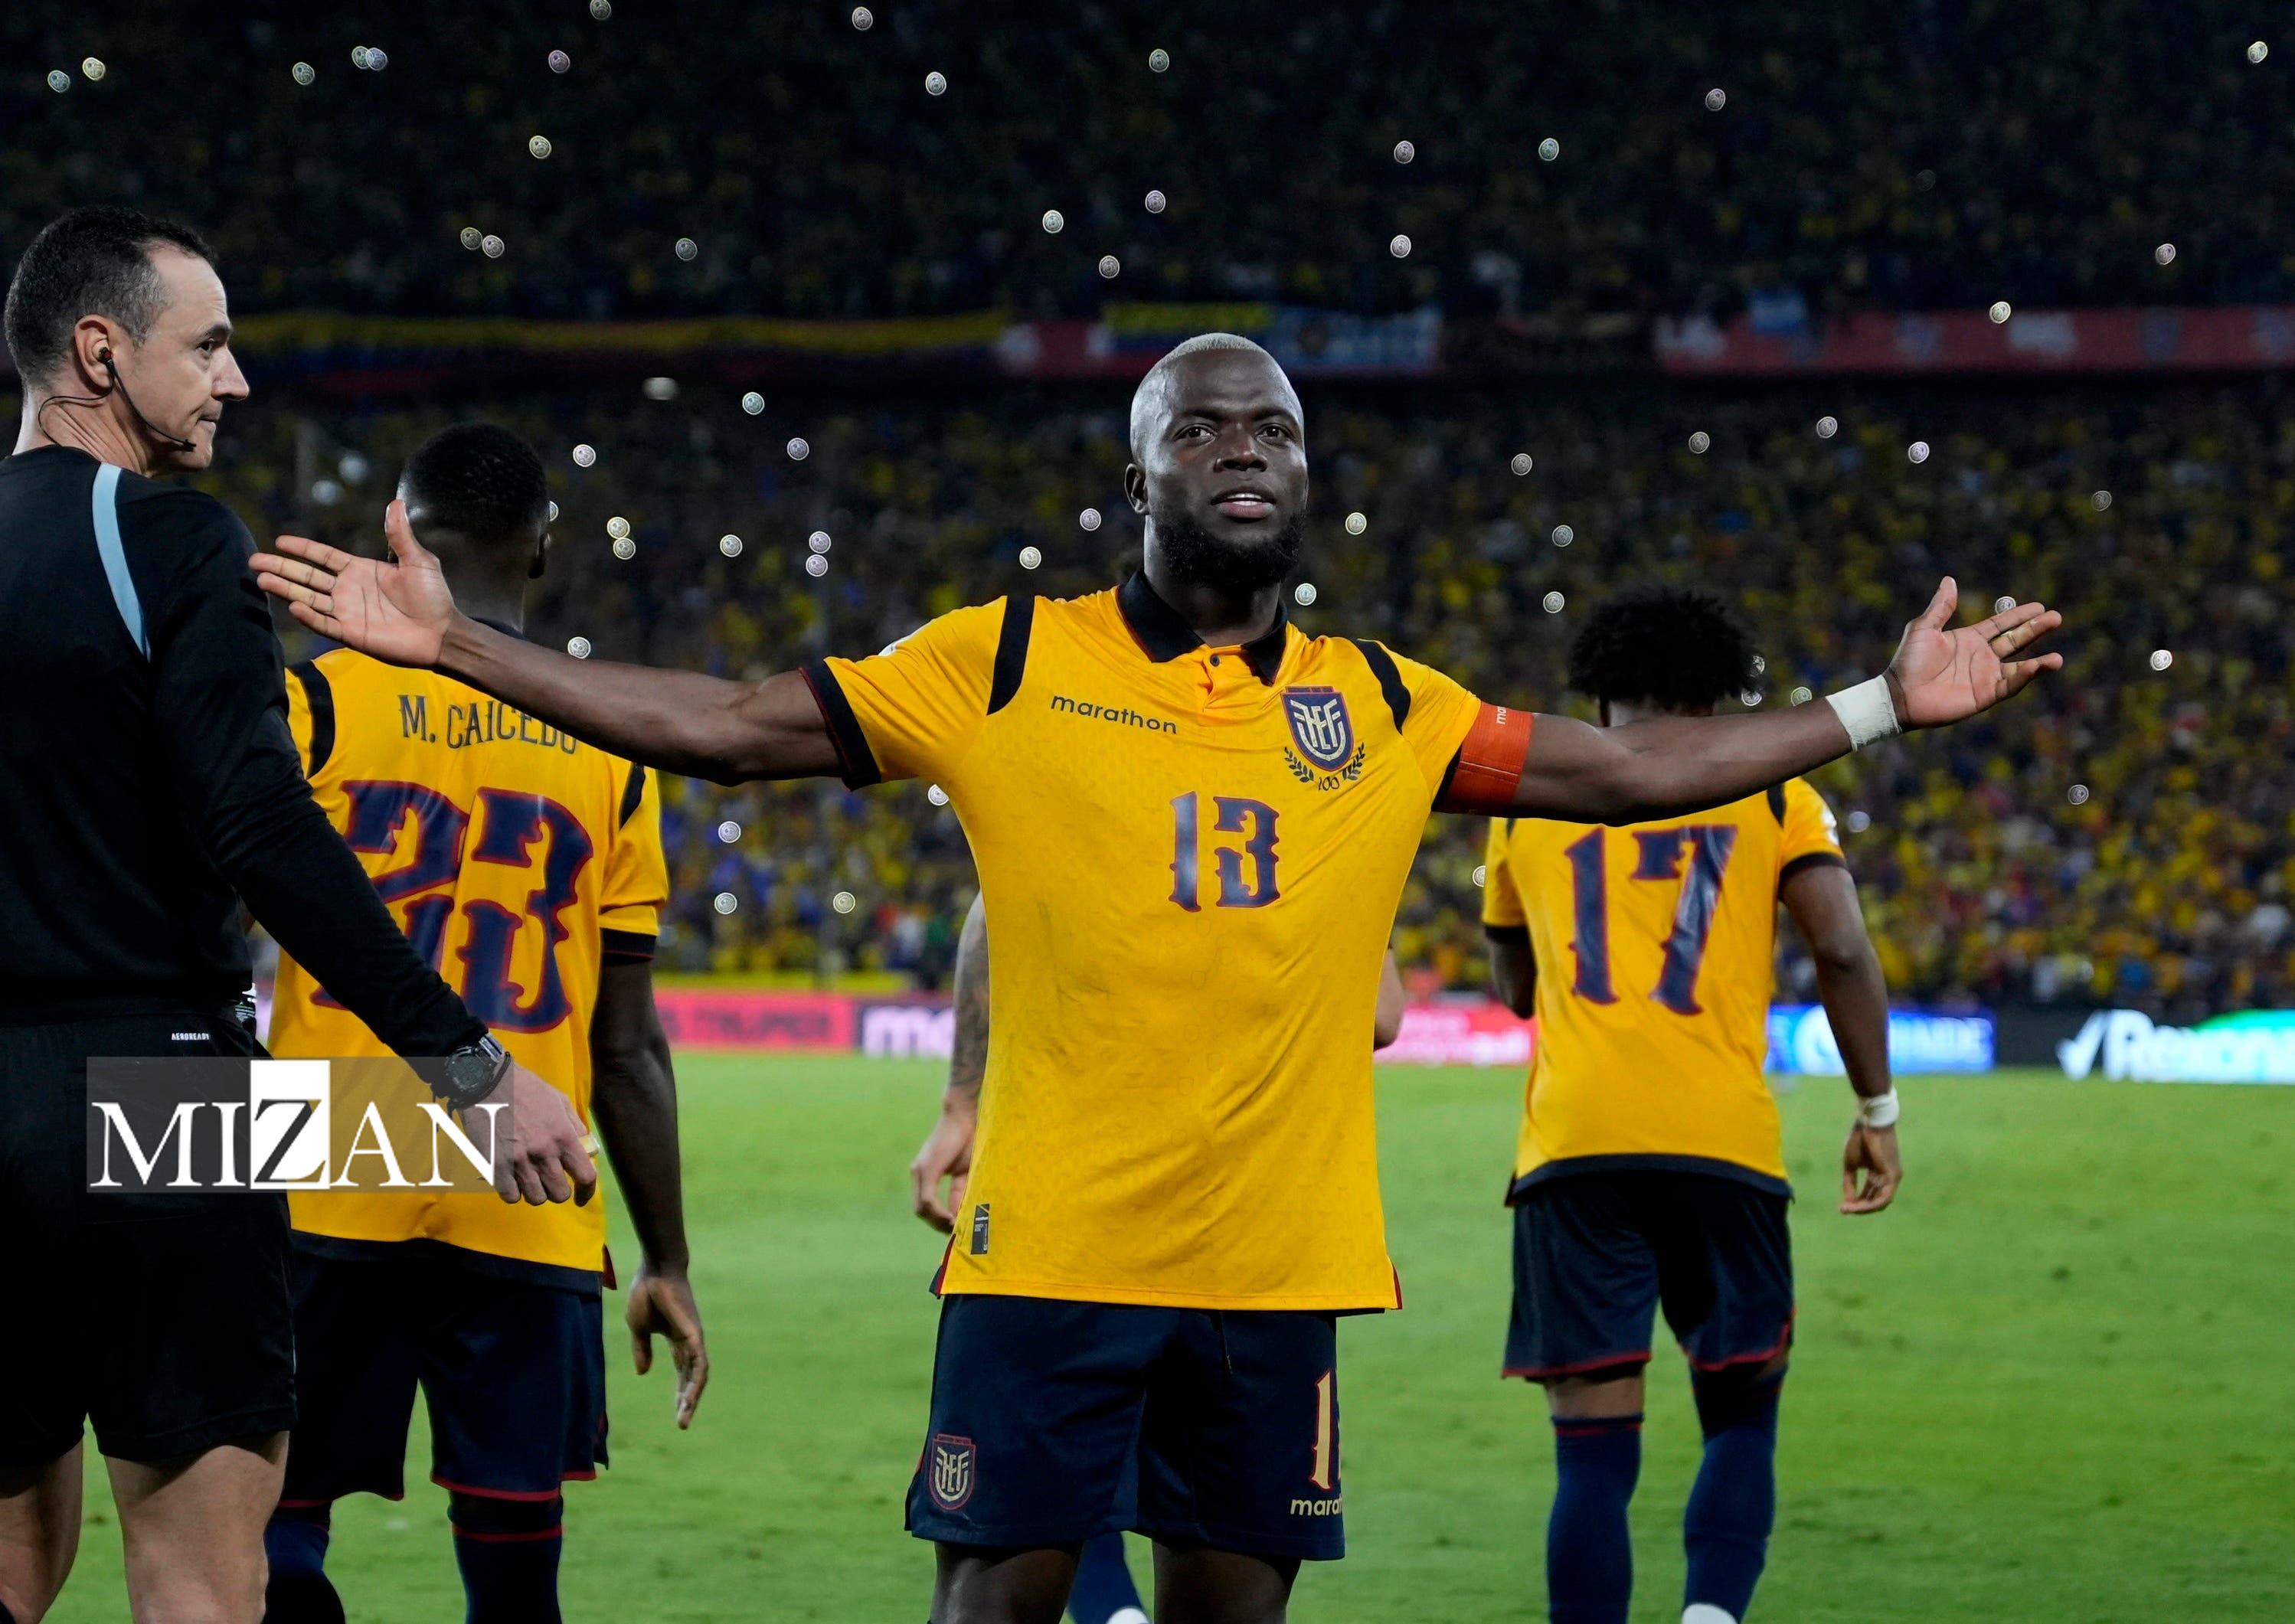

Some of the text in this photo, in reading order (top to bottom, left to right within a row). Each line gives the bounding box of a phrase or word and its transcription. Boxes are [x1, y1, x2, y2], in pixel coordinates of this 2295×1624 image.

[397, 694, 436, 743] M.
[1050, 695, 1178, 734] marathon
[1318, 776, 1340, 792] 100
[1169, 790, 1281, 913] 13
[309, 779, 594, 1034] 23
[1564, 822, 1739, 1016] 17
[171, 1032, 210, 1041] AEROREADY
